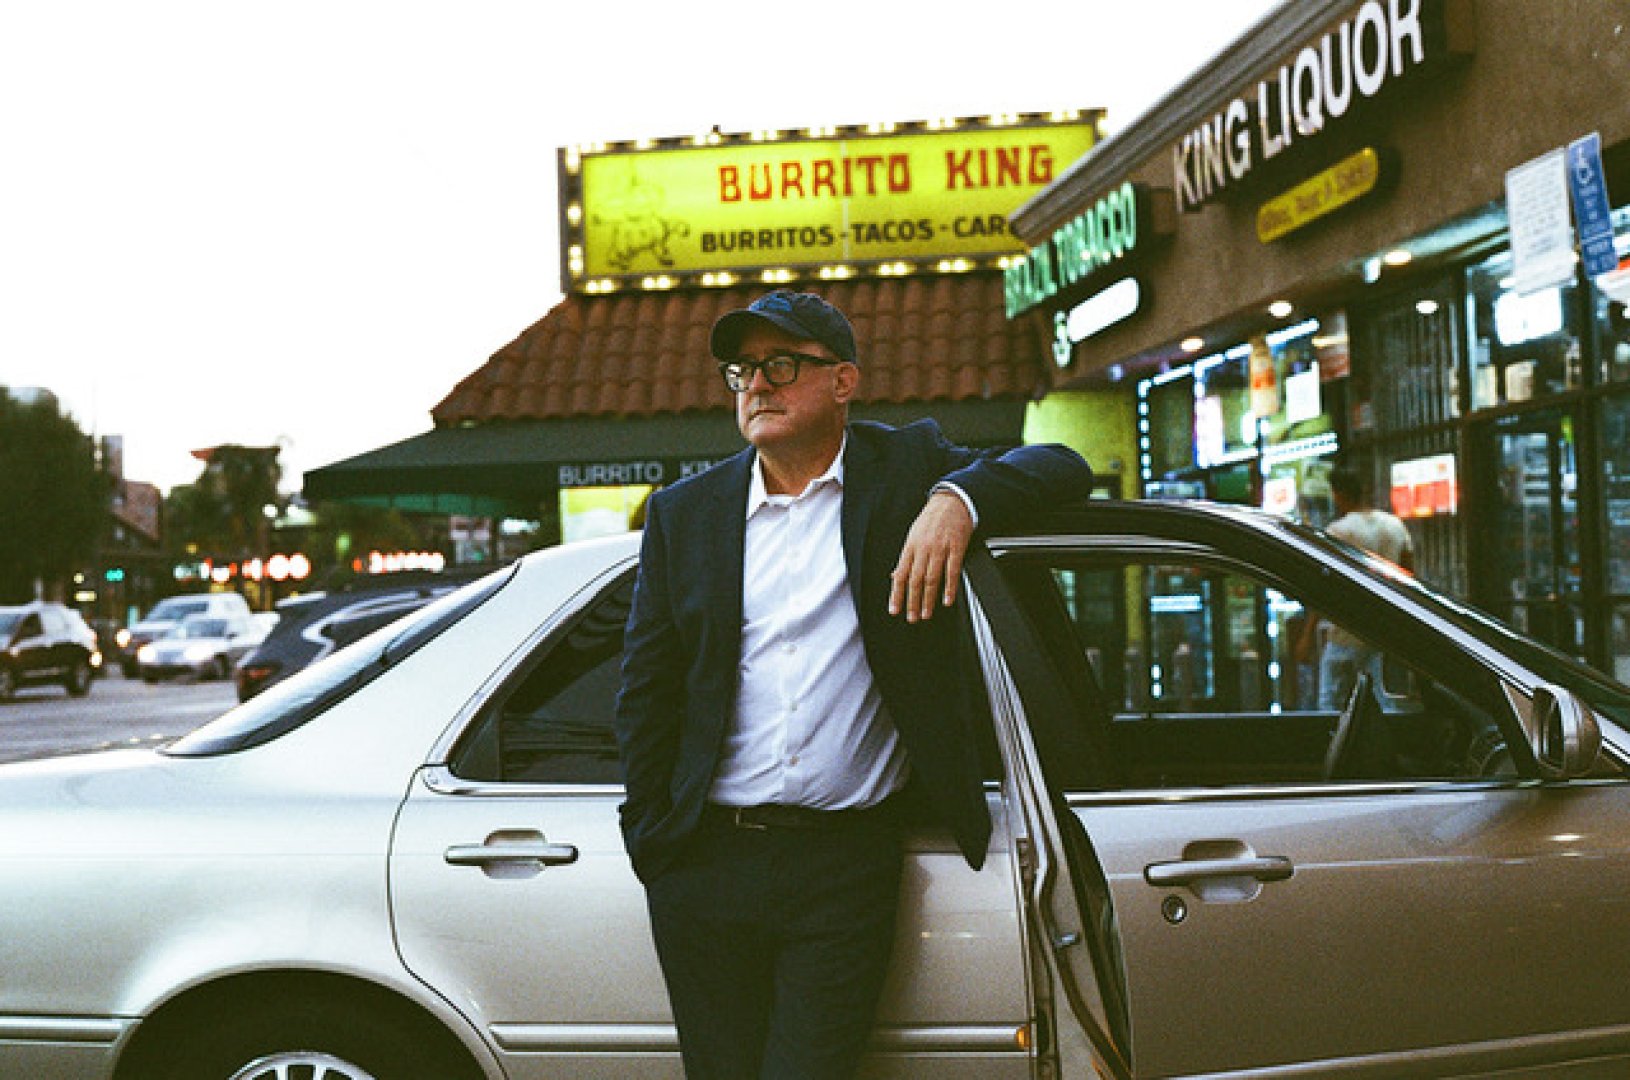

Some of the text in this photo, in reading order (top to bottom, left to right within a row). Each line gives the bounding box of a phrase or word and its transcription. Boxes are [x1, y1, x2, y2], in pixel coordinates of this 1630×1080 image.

[1173, 98, 1251, 214] KING
[1257, 0, 1425, 160] LIQUOR
[719, 143, 1054, 204] BURRITO KING
[559, 460, 663, 486] BURRITO
